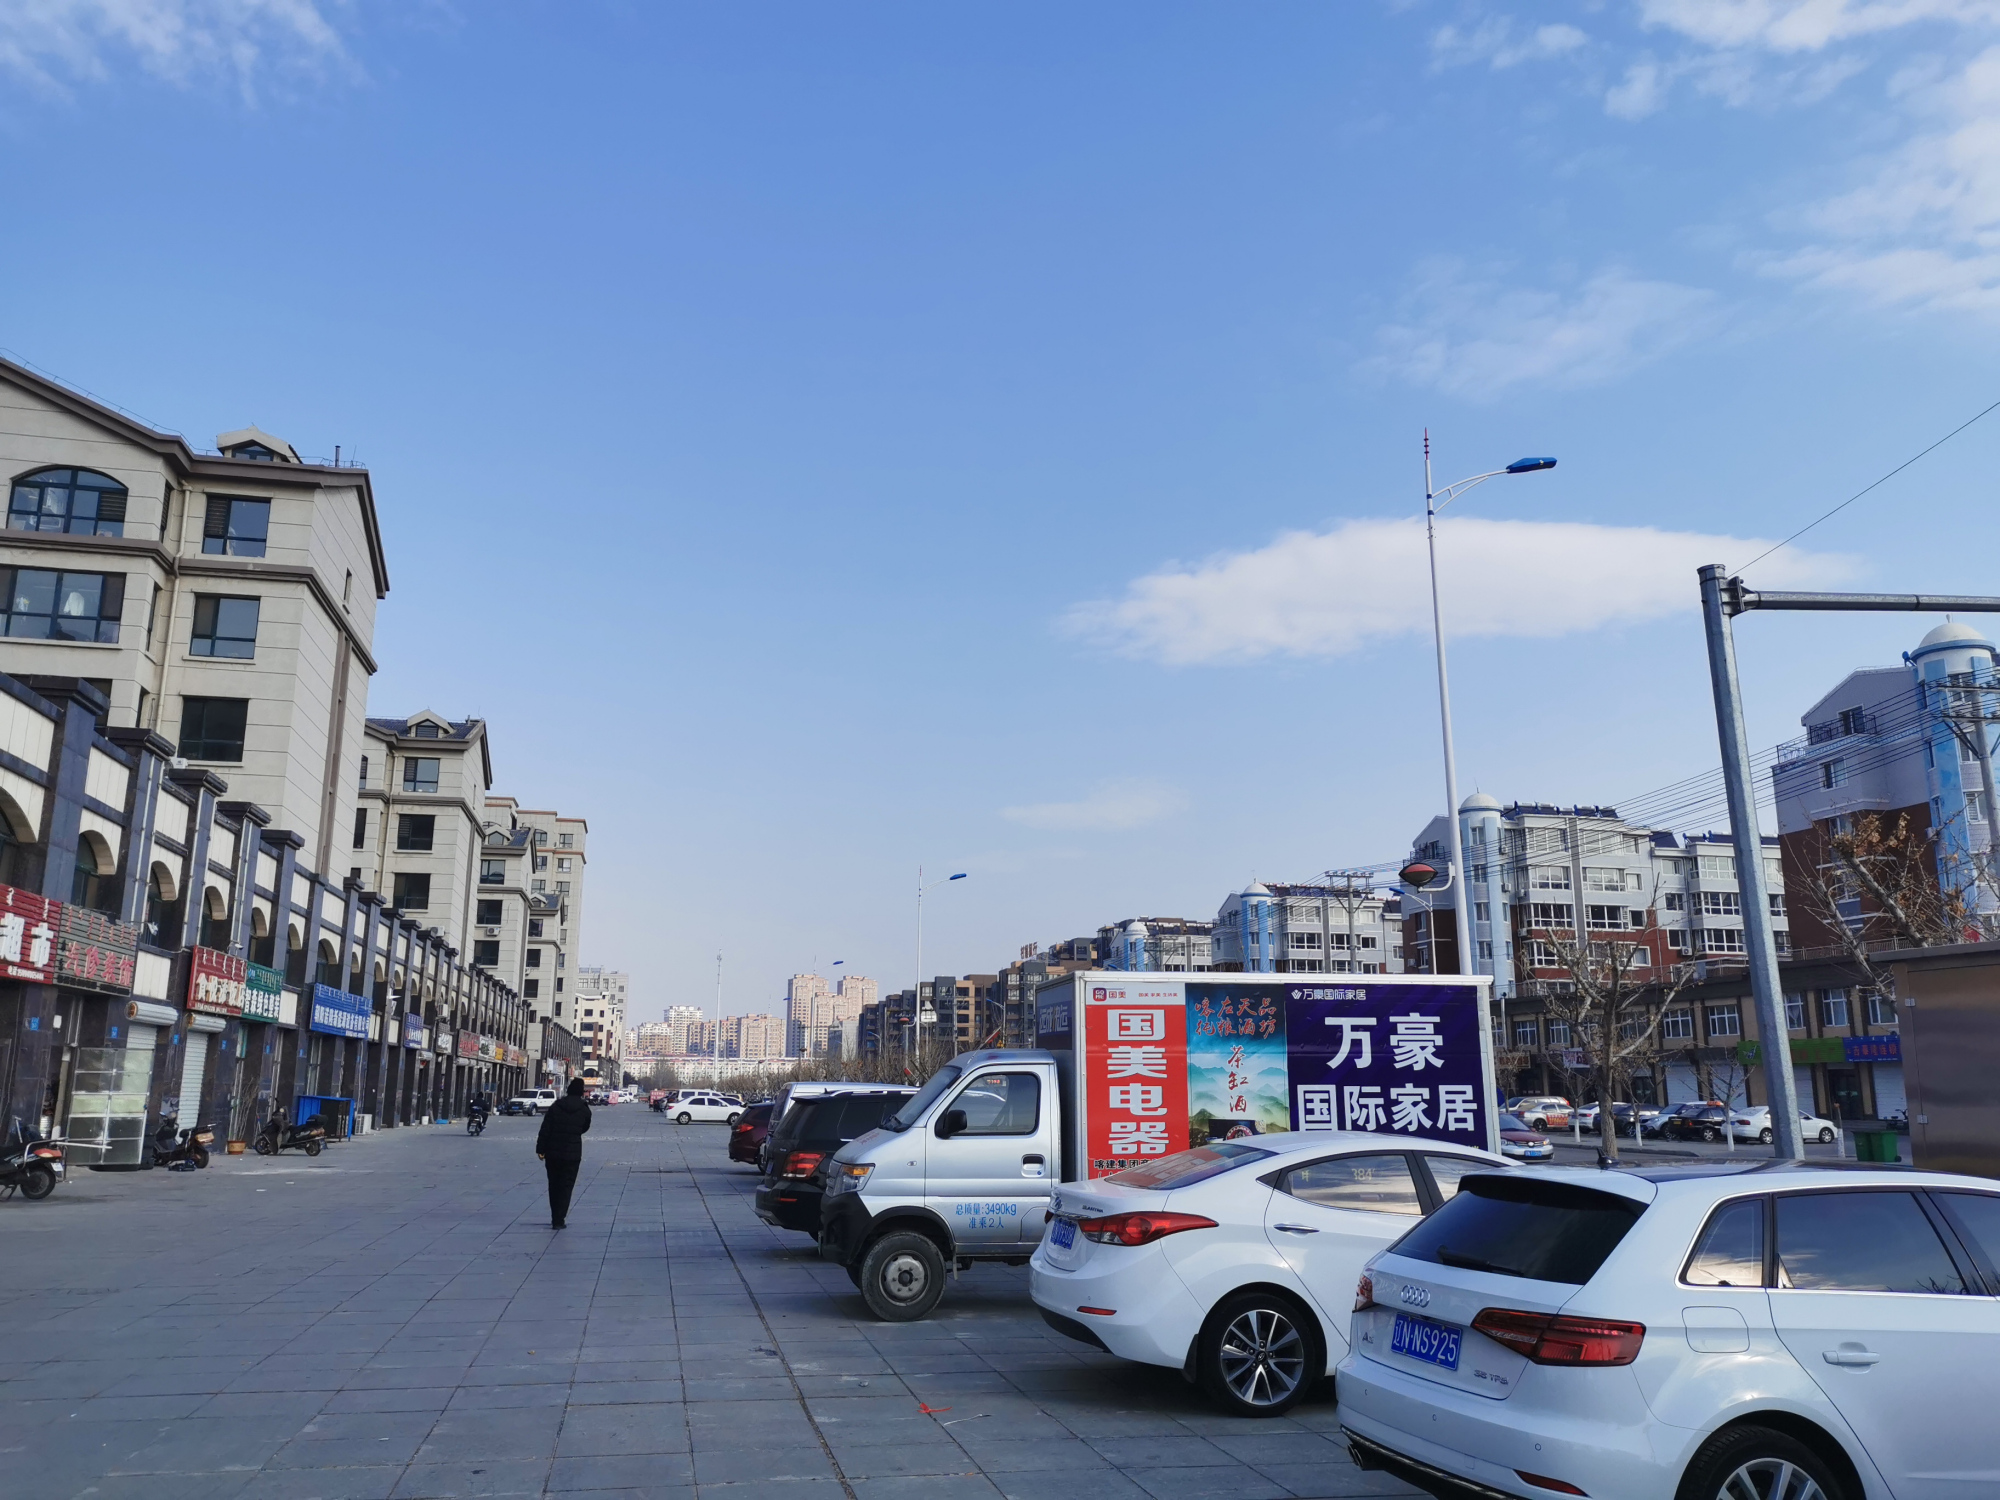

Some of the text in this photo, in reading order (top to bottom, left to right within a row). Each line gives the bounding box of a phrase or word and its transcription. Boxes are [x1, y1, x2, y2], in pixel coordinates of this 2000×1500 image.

[65, 941, 134, 986] 汽修装饰
[1303, 989, 1366, 1000] 万豪国际家居
[1325, 1012, 1445, 1071] 万豪
[1107, 1009, 1169, 1154] 国美电器
[1228, 1045, 1249, 1113] 茶缸酒
[1297, 1083, 1477, 1131] 国际家居
[956, 1203, 1017, 1216] 总质量:3490kg
[968, 1216, 1004, 1229] 准乘2人
